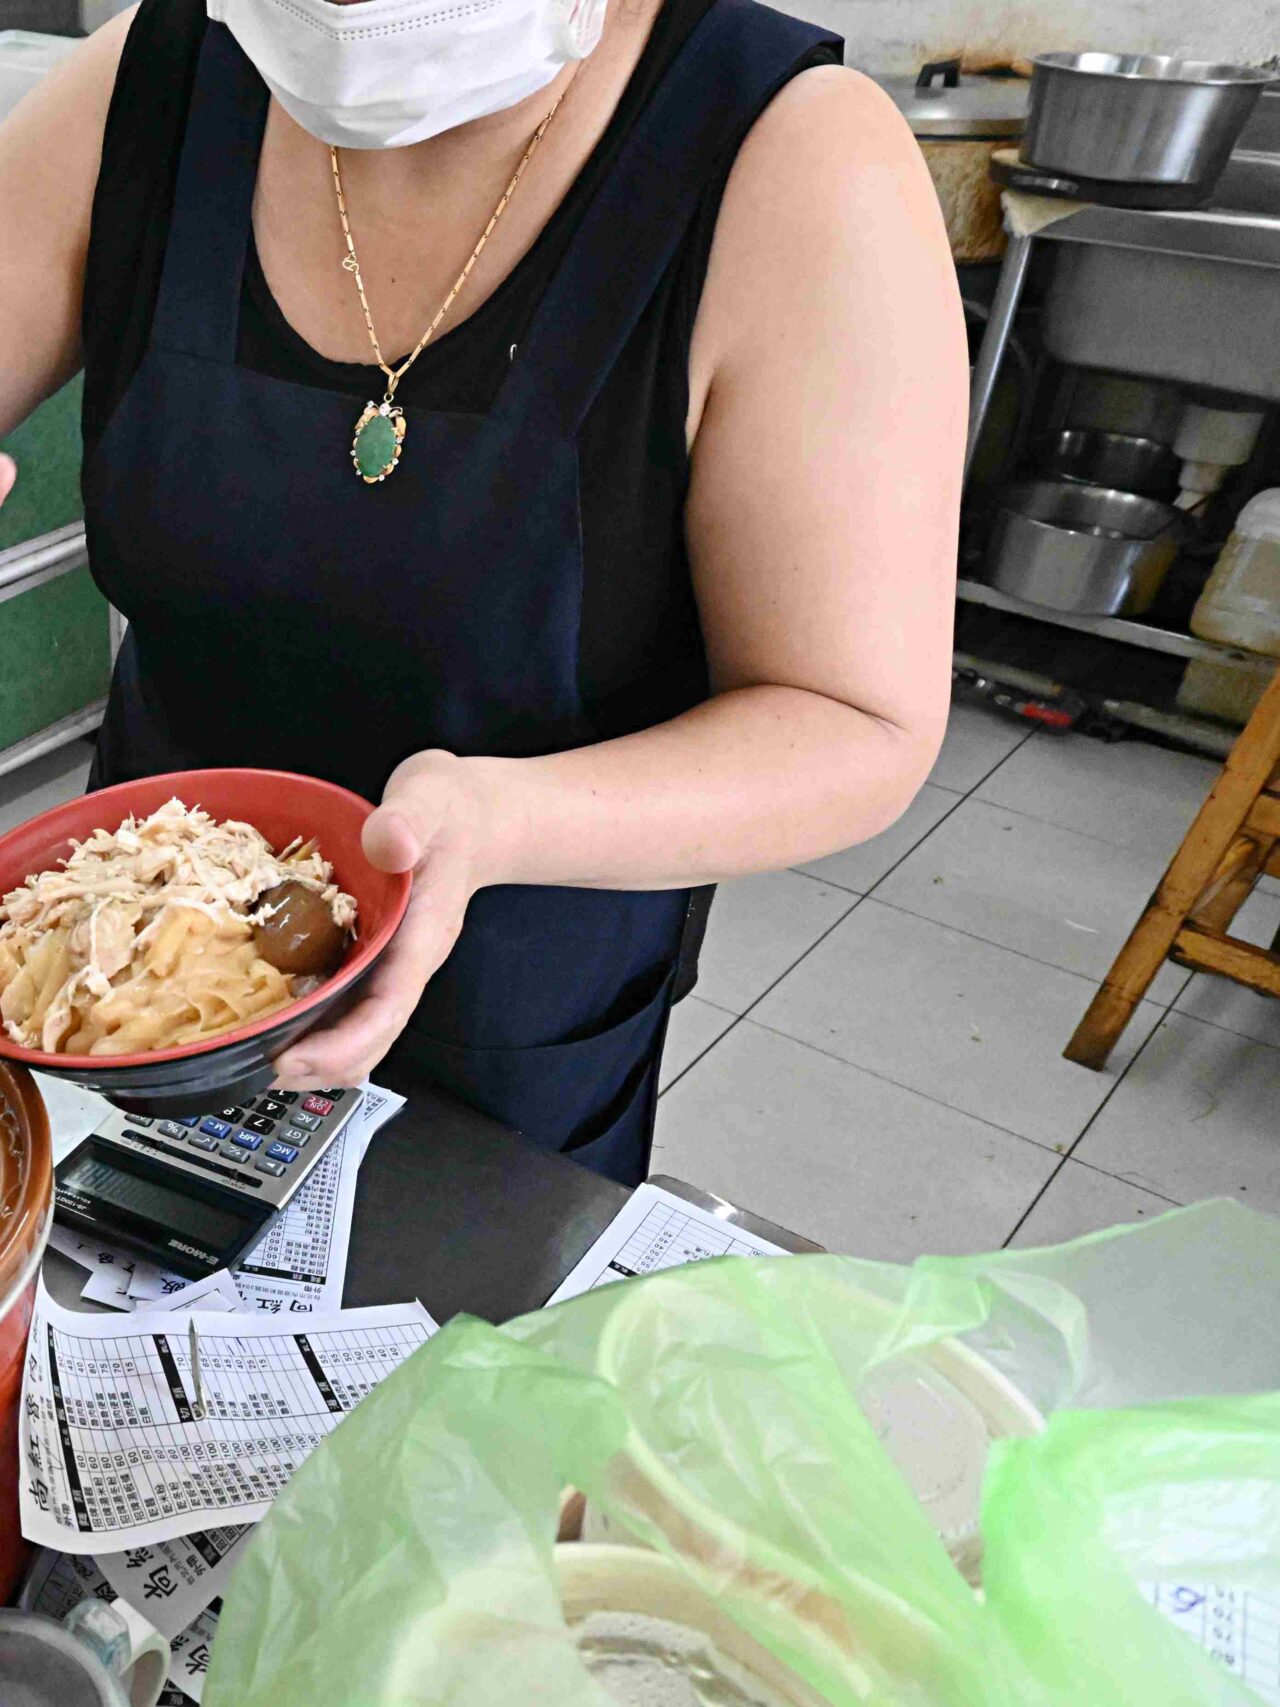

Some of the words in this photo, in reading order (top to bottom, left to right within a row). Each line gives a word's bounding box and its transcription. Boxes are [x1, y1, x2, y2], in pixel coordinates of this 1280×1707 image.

[266, 1102, 277, 1112] 4
[254, 1117, 265, 1126] 7
[297, 1113, 312, 1123] AC
[239, 1132, 256, 1142] MR
[285, 1129, 300, 1139] GT
[275, 1144, 291, 1156] MC
[167, 1237, 220, 1265] E-MORE
[342, 1351, 352, 1362] 50
[354, 1350, 364, 1361] 50
[365, 1349, 376, 1359] 40
[377, 1347, 387, 1359] 40
[389, 1346, 399, 1356] 40
[176, 1356, 185, 1367] 70
[212, 1357, 221, 1368] 65
[223, 1357, 232, 1369] 45
[235, 1358, 244, 1369] 40
[258, 1358, 267, 1368] 15
[319, 1353, 328, 1364] 55
[331, 1352, 341, 1363] 55
[76, 1361, 84, 1373] 40
[99, 1362, 108, 1374] 75
[112, 1362, 121, 1373] 70
[125, 1361, 134, 1372] 15
[138, 1406, 151, 1423] 白飯
[231, 1441, 243, 1457] 100
[244, 1441, 255, 1455] 100
[257, 1439, 268, 1453] 100
[270, 1437, 281, 1452] 100
[282, 1436, 294, 1450] 100
[141, 1448, 151, 1460] 60
[154, 1448, 164, 1459] 60
[167, 1448, 177, 1460] 60
[180, 1445, 190, 1461] 100
[193, 1443, 204, 1460] 100
[206, 1441, 217, 1458] 100
[219, 1441, 230, 1458] 100
[76, 1454, 85, 1467] 60
[88, 1455, 98, 1469] 60
[101, 1455, 111, 1469] 60
[114, 1454, 124, 1466] 60
[127, 1450, 137, 1463] 60
